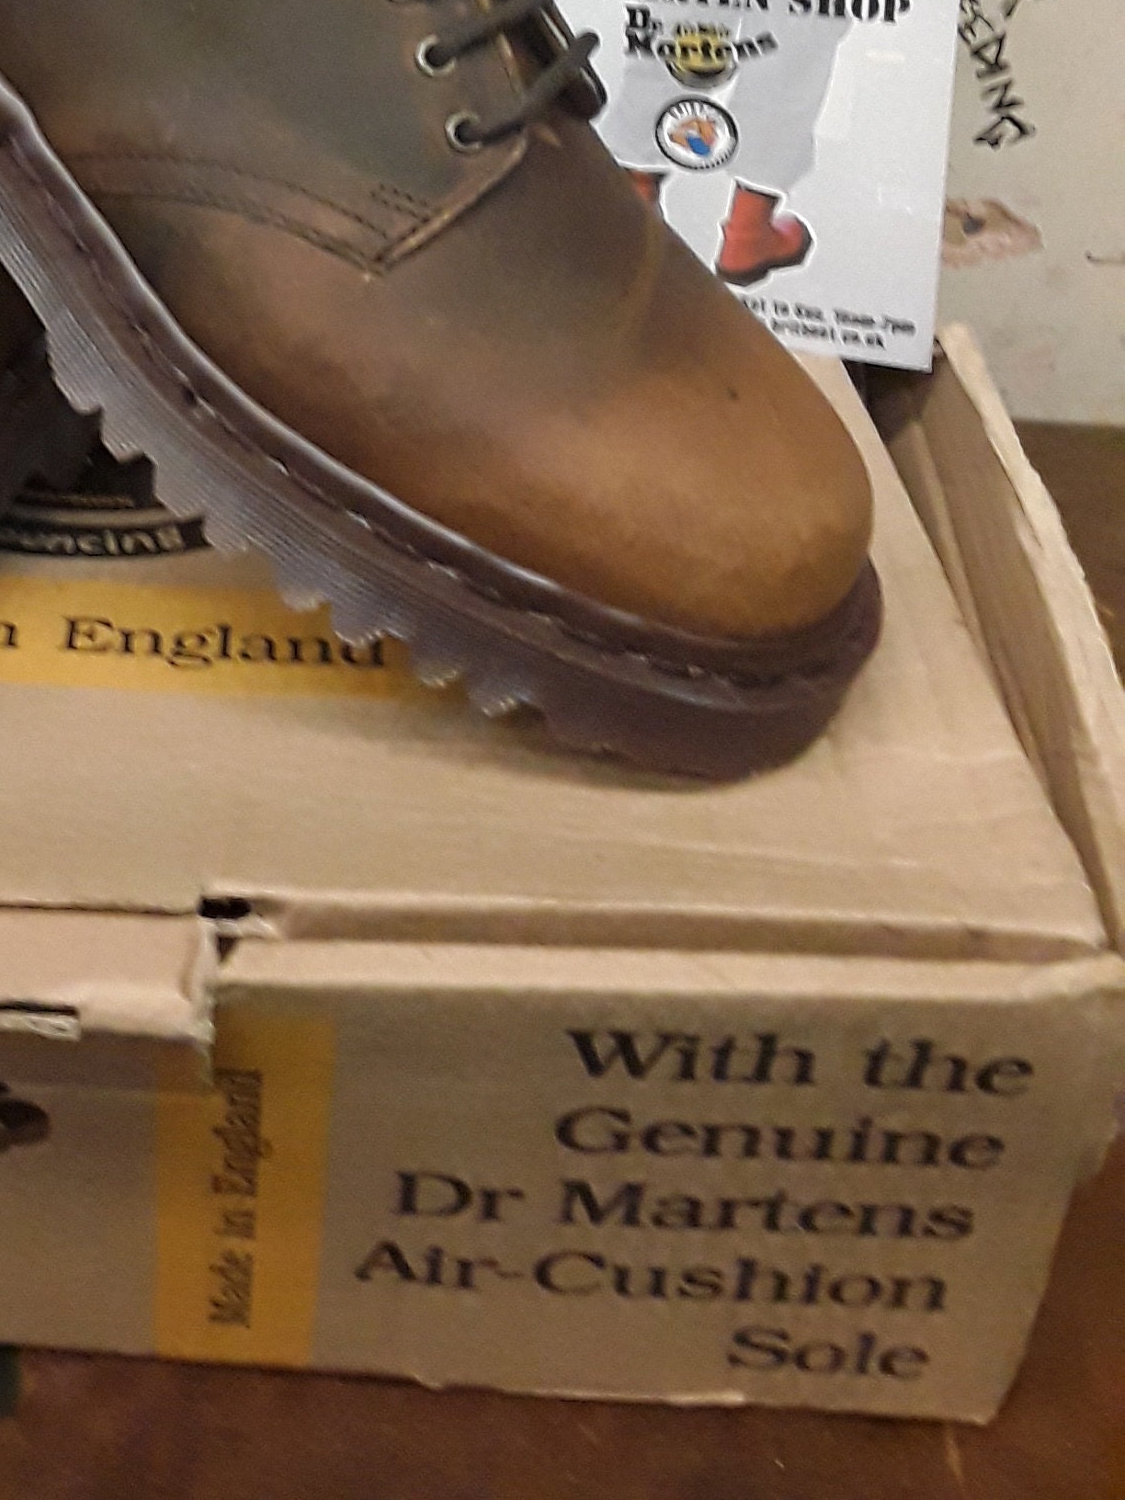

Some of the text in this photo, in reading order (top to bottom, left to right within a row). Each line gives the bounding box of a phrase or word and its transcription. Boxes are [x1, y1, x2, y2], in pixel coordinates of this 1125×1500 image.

[61, 612, 386, 669] England
[563, 1025, 1036, 1098] With the
[552, 1105, 1006, 1172] Genuine
[208, 1067, 273, 1326] Made in England
[391, 1169, 976, 1243] Dr Martens
[353, 1236, 949, 1313] Air-Cushion
[725, 1326, 932, 1382] Sole
